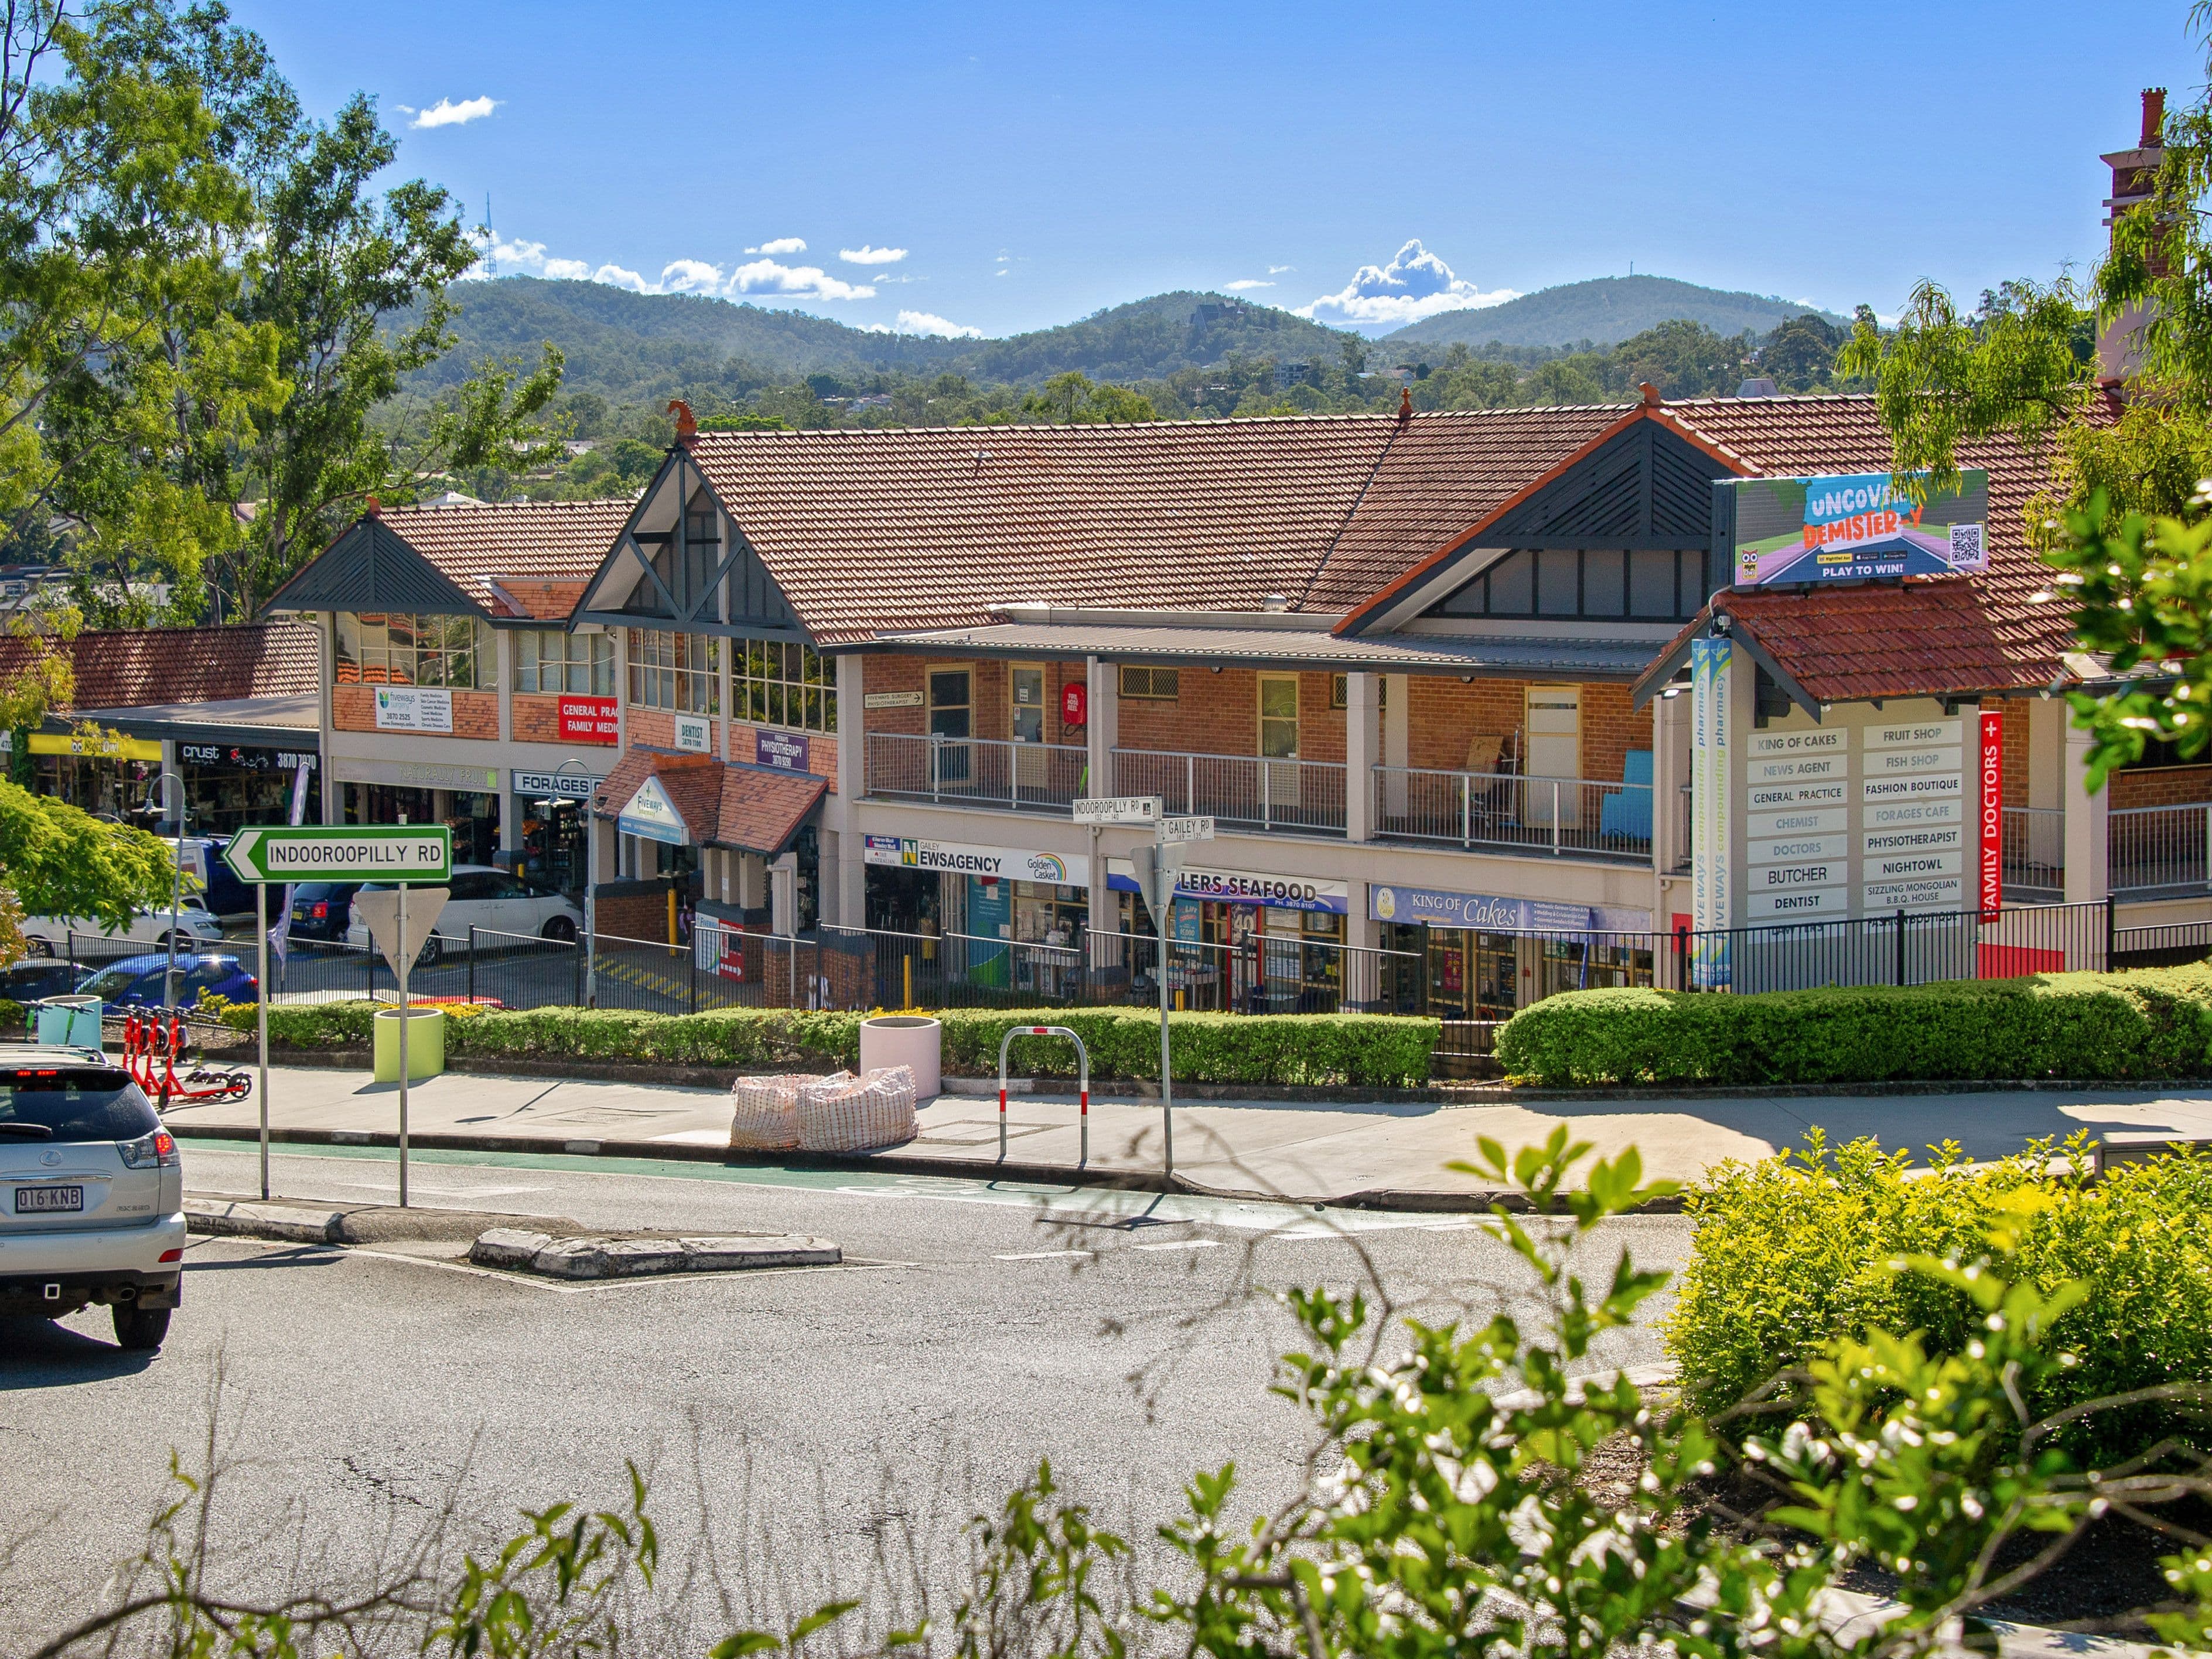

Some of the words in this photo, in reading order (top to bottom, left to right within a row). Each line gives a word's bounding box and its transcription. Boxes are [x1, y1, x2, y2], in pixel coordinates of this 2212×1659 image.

[1812, 483, 1907, 517] UNCOVE
[1822, 566, 1852, 577] PLAY
[1856, 565, 1872, 575] TO
[1875, 564, 1903, 574] WIN!
[390, 692, 415, 704] fiveways
[563, 705, 597, 716] GENERAL
[1696, 674, 1706, 747] pharmacy
[1715, 674, 1725, 746] pharmacy
[568, 721, 593, 732] FAMILY
[682, 725, 702, 739] DENTIST
[1884, 730, 1910, 741] FRUIT
[1914, 728, 1941, 739] SHOP
[762, 740, 802, 757] PHYSIOTHERAPY
[1758, 739, 1784, 750] KING
[1788, 737, 1801, 748] OF
[1804, 735, 1836, 746] CAKES
[183, 746, 219, 759] crust
[278, 753, 297, 768] 3870
[772, 756, 781, 765] 3870
[783, 757, 791, 766] 9290
[1886, 757, 1907, 767] FISH
[1911, 755, 1939, 766] SHOP
[400, 765, 455, 781] NATURALLY
[460, 769, 487, 784] FRUIT
[1764, 764, 1793, 776] NEWS
[1797, 762, 1831, 774] AGENT
[523, 776, 588, 792] FORAGES
[1866, 783, 1907, 794] FASHION
[1911, 780, 1958, 791] BOUTIQUE
[1984, 745, 1997, 838] DOCTORS
[1697, 749, 1706, 851] compounding
[1715, 749, 1726, 852] compounding
[1754, 792, 1794, 803] GENERAL
[1799, 788, 1841, 800] PRACTICE
[637, 796, 662, 813] FIVEWAYS
[1075, 801, 1127, 814] INDOOROOPILLY
[1131, 800, 1139, 813] RD
[1876, 808, 1922, 821] FORAGES
[1926, 806, 1949, 817] CAFE
[1169, 821, 1196, 834] GAILEY
[1201, 820, 1209, 832] RD
[1776, 816, 1818, 829] CHEMIST
[920, 842, 940, 851] GAILEY
[1868, 832, 1957, 848] PHYSIOTHERAPIST
[271, 845, 408, 863] INDOOROOPILLY
[418, 845, 441, 862] RD
[1774, 842, 1821, 856] DOCTORS
[1028, 858, 1052, 870] Golden
[1883, 859, 1942, 873] NIGHTOWL
[1034, 869, 1056, 880] Casket
[1769, 867, 1827, 884] BUTCHER
[1984, 847, 1997, 916] FAMILY
[1176, 872, 1223, 893] LERS
[1228, 877, 1316, 902] SEAFOOD
[1868, 885, 1903, 895] SIZZLING
[1906, 880, 1957, 892] MONGOLIAN
[1695, 854, 1706, 940] FIVEWAYS
[1714, 855, 1727, 940] FIVEWAYS
[1775, 896, 1820, 909] DENTIST
[1887, 895, 1909, 904] B.B.Q.
[1912, 892, 1938, 902] HOUSE
[1412, 894, 1443, 910] KING
[1446, 897, 1460, 910] OF
[1464, 897, 1517, 928] Cakes
[19, 1191, 45, 1206] 016
[50, 1189, 79, 1205] KNB
